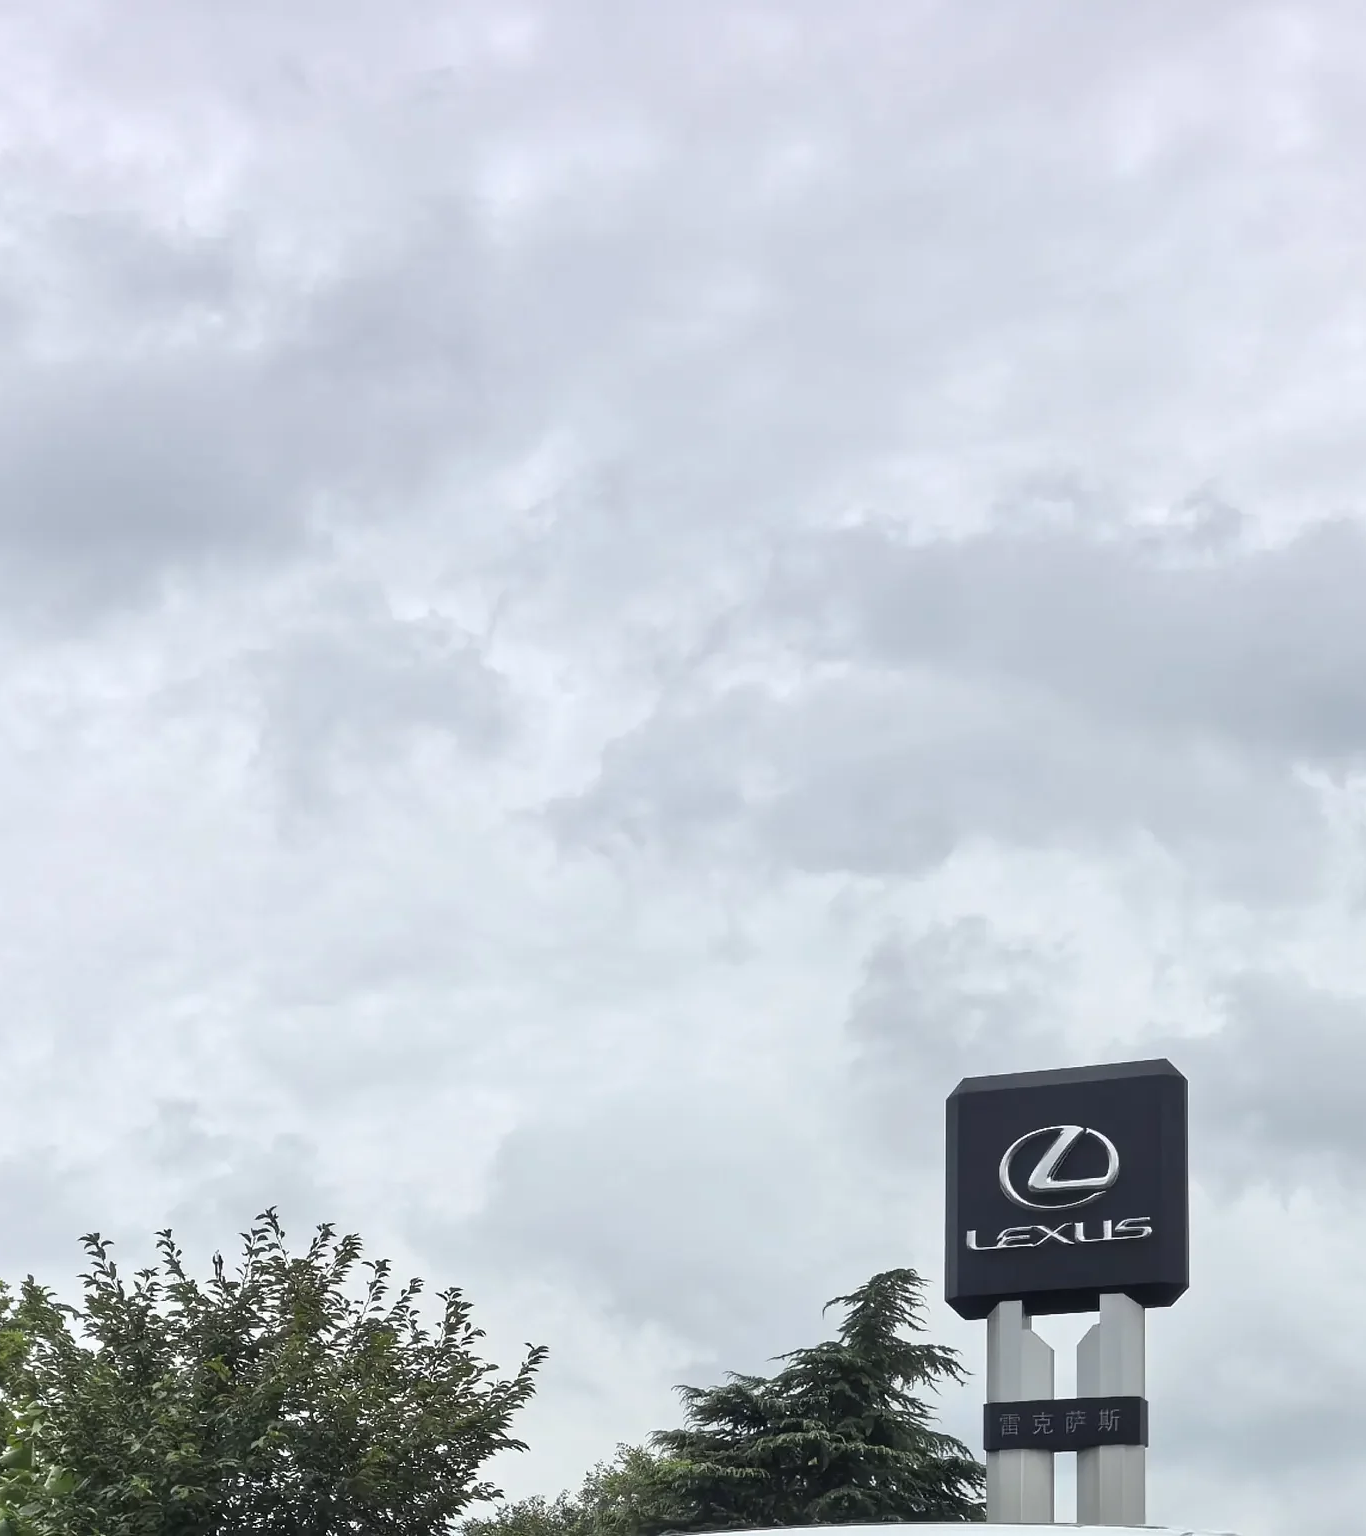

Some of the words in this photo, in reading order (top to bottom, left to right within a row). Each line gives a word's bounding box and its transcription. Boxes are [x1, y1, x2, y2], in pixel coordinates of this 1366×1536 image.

[966, 1217, 1153, 1251] LEXUS
[999, 1408, 1122, 1438] 雷克萨斯
